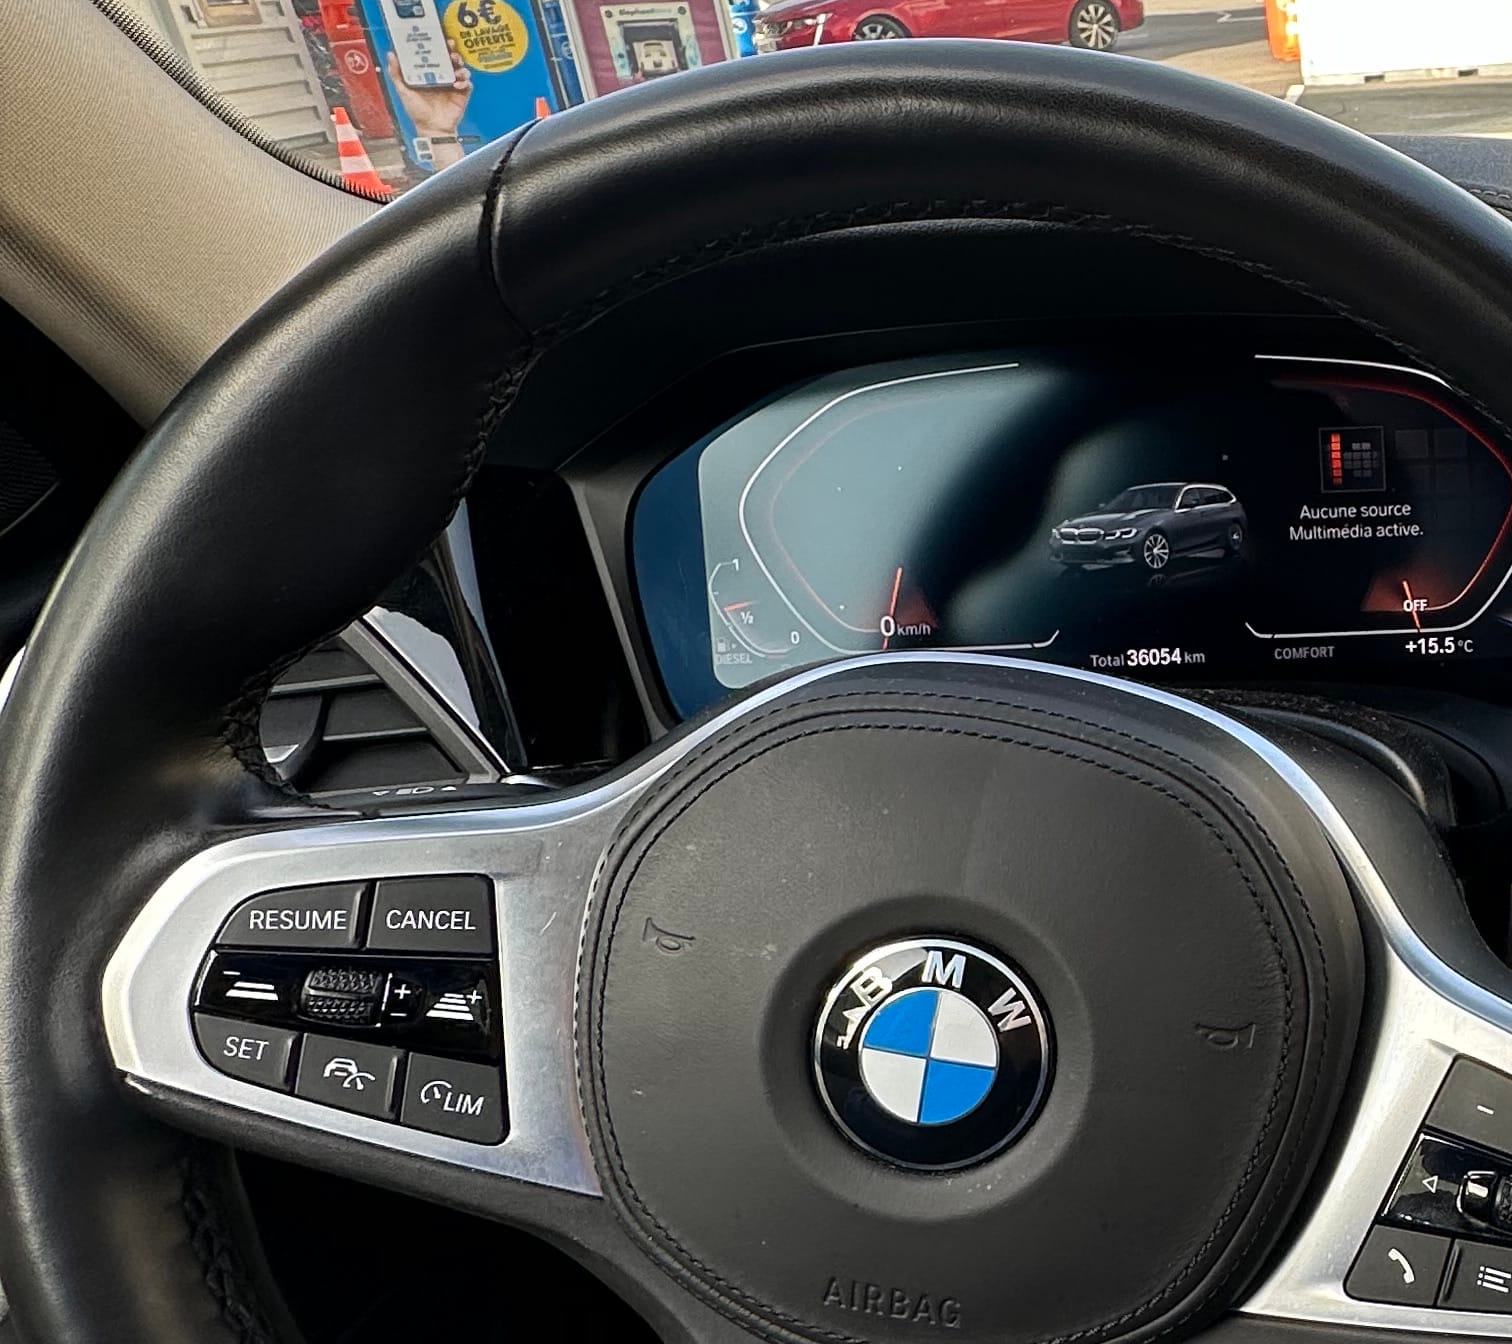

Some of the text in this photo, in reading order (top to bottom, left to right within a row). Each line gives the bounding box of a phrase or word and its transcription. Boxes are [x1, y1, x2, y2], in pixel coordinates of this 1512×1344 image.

[464, 32, 514, 49] OFFERTS
[1300, 504, 1411, 519] Aucune source
[1289, 522, 1424, 541] Multimédia active.
[1403, 598, 1428, 613] OFF
[880, 615, 931, 637] 0 km/h
[791, 631, 800, 645] 0
[1405, 637, 1455, 655] +15.5
[716, 653, 753, 665] DIESEL
[1090, 648, 1206, 668] Total 36054 km
[1274, 646, 1335, 660] COMFORT
[249, 909, 347, 931] RESUME
[385, 908, 476, 931] CANCEL
[852, 950, 1033, 1035] BMW
[223, 1036, 270, 1061] SET
[443, 1092, 485, 1117] LIM
[822, 1275, 962, 1329] AIRBAG
